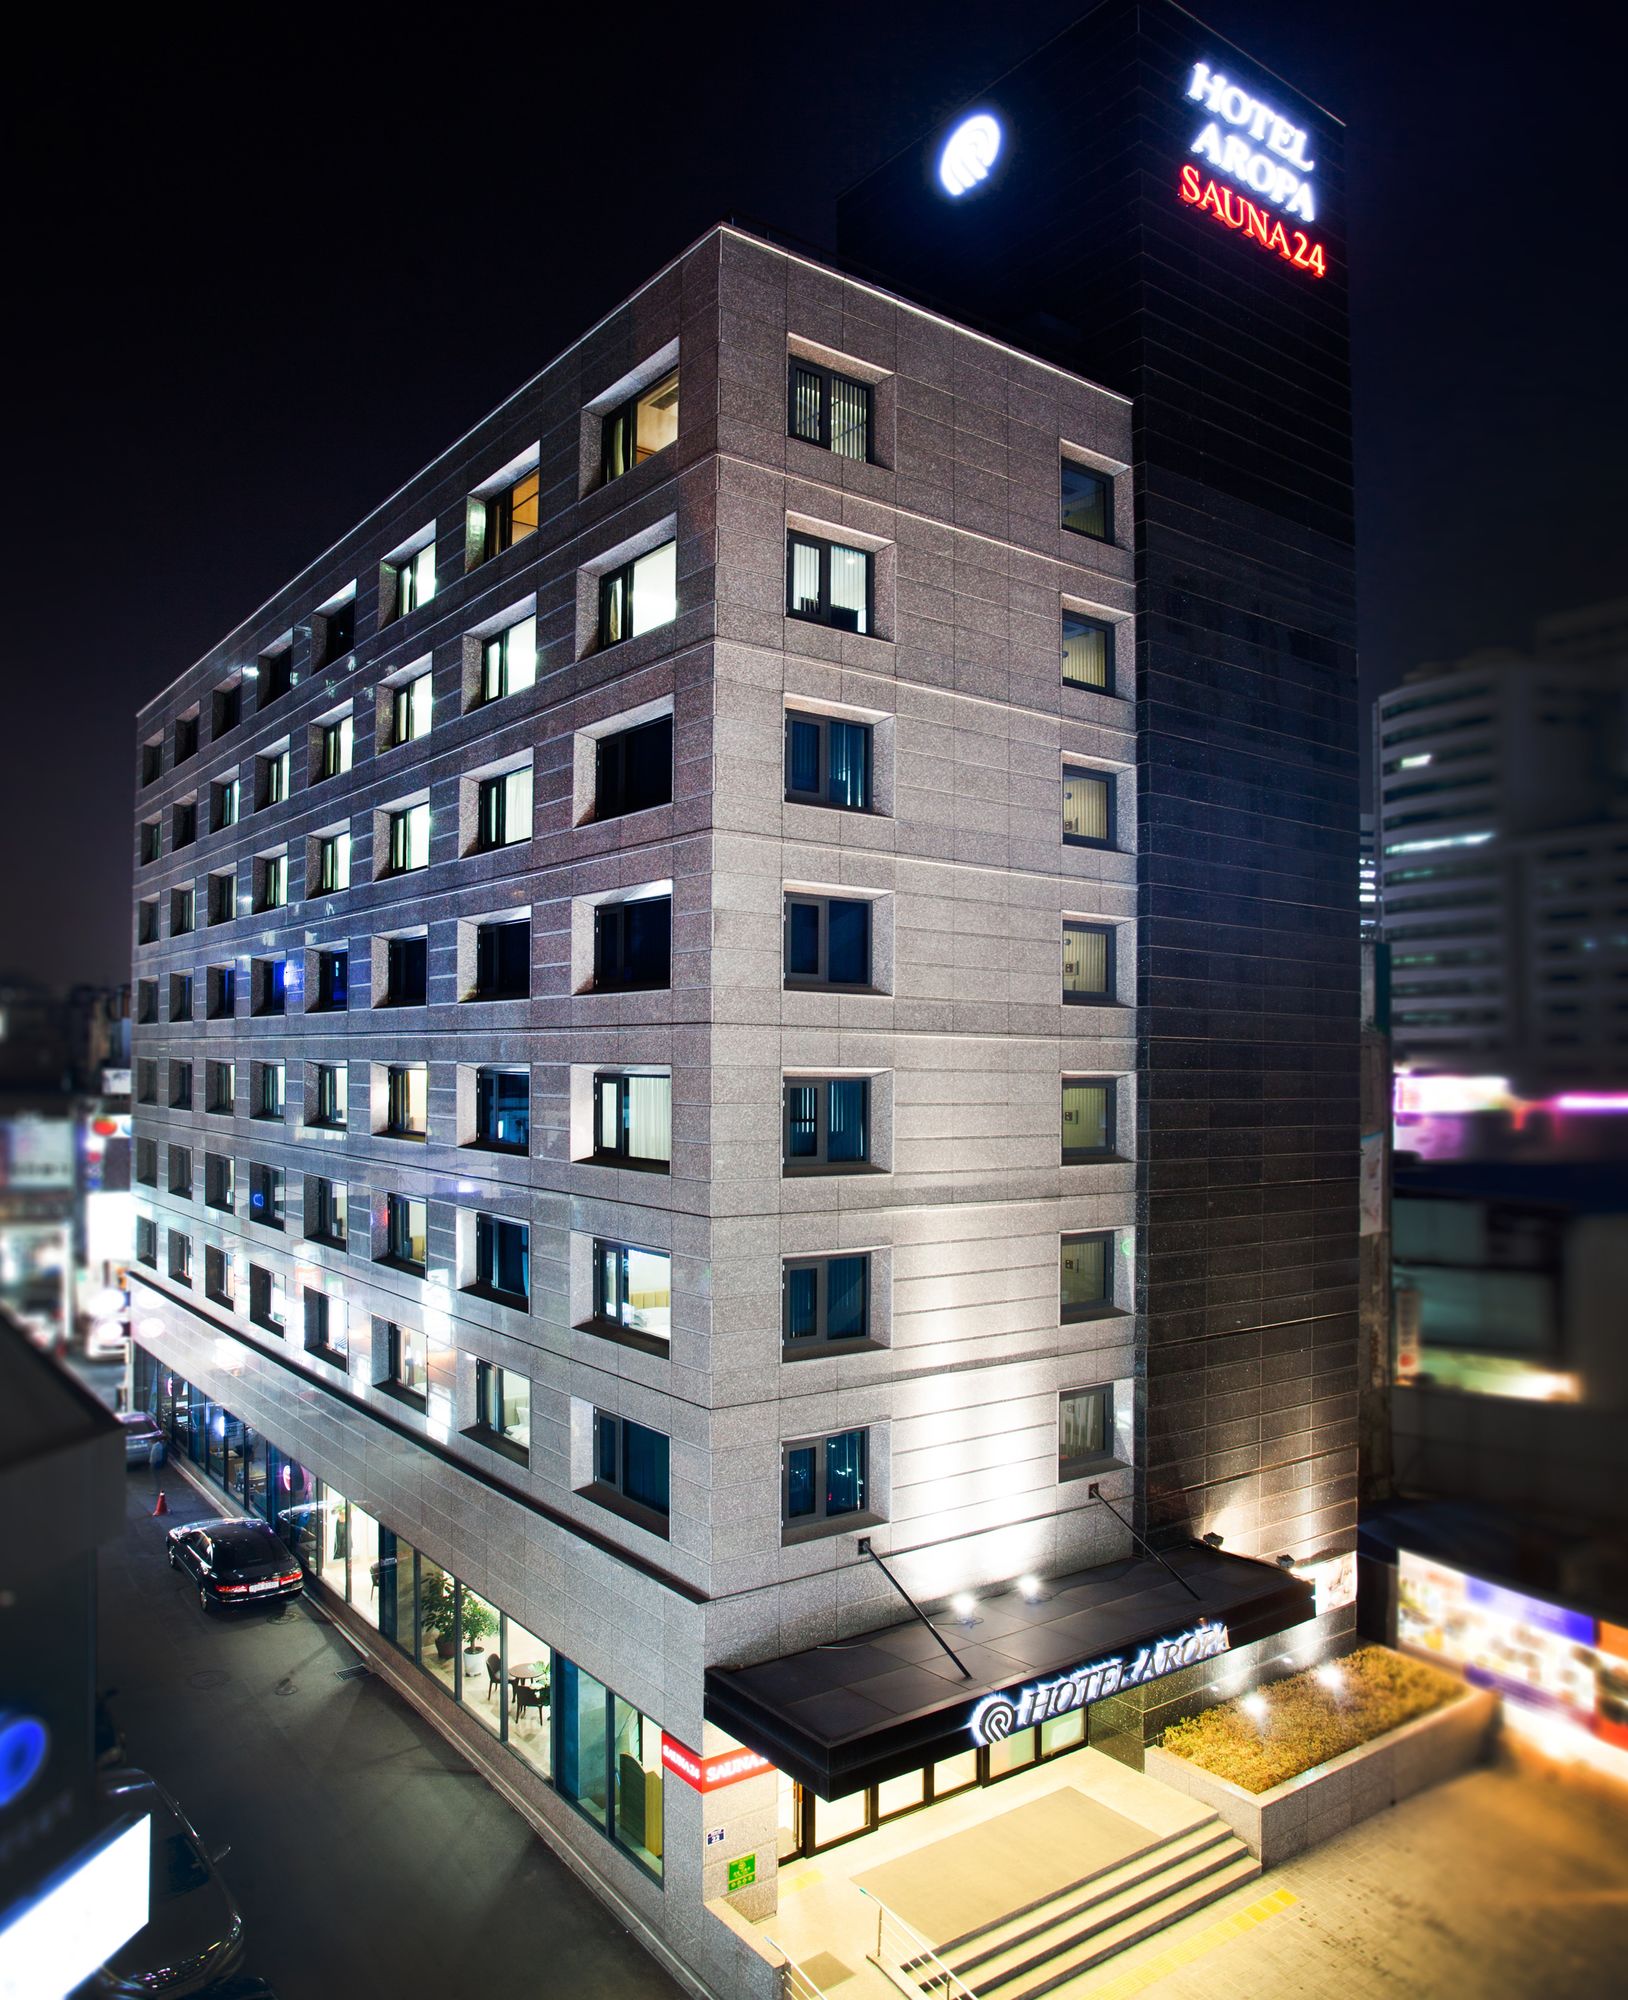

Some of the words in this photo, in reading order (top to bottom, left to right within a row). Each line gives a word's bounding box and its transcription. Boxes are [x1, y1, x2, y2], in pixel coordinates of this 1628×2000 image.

[1186, 62, 1314, 172] HOTEL
[1190, 122, 1315, 222] AROPA
[1022, 1657, 1133, 1727] HOTEL
[1134, 1622, 1231, 1682] AROPA
